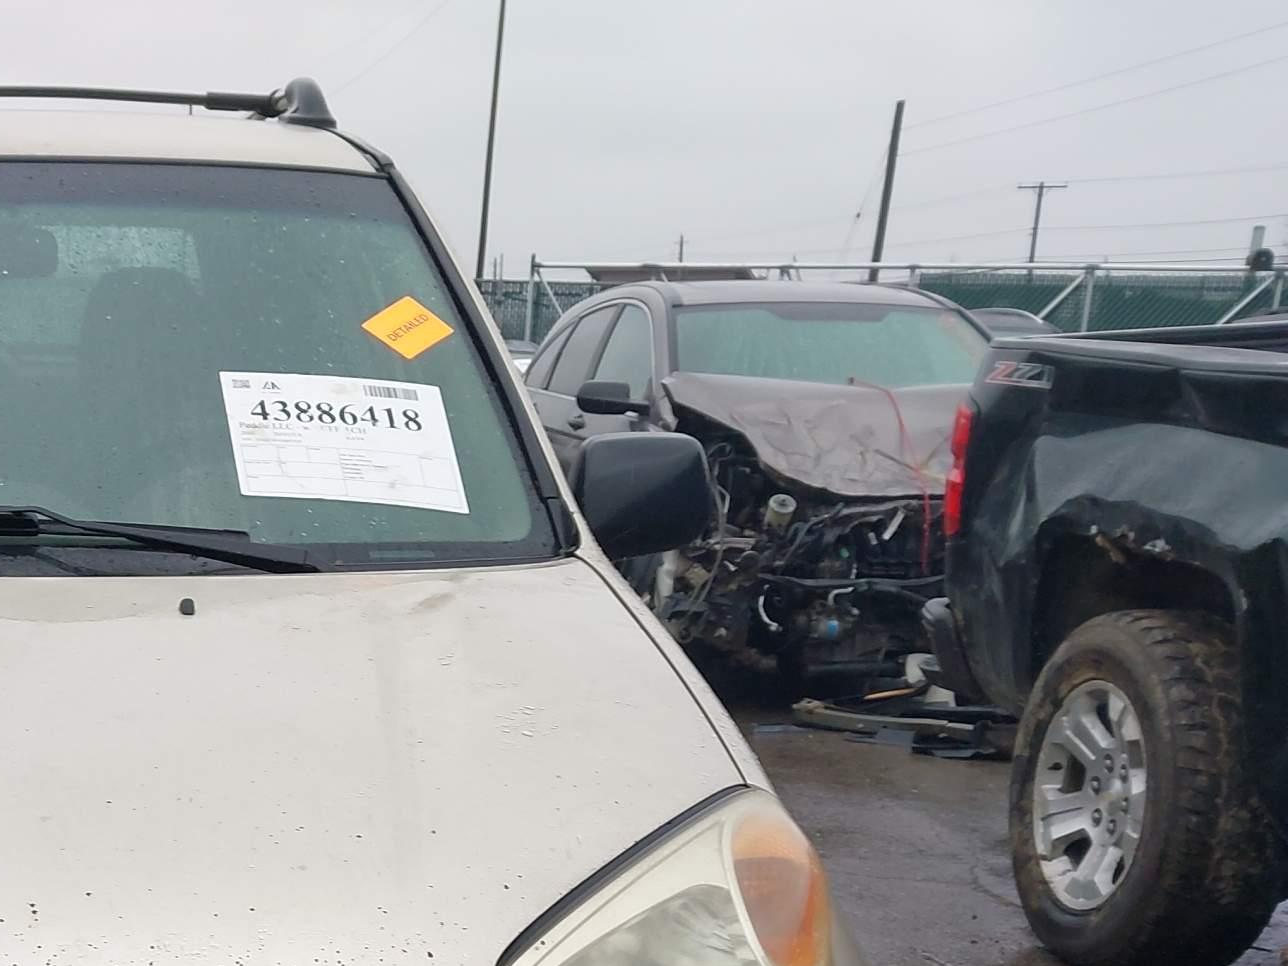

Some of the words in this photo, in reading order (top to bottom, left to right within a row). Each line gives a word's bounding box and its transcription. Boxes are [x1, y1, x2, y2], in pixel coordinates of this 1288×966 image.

[386, 313, 429, 342] DETAILED
[984, 360, 1055, 389] Z71
[250, 399, 423, 432] 43886418
